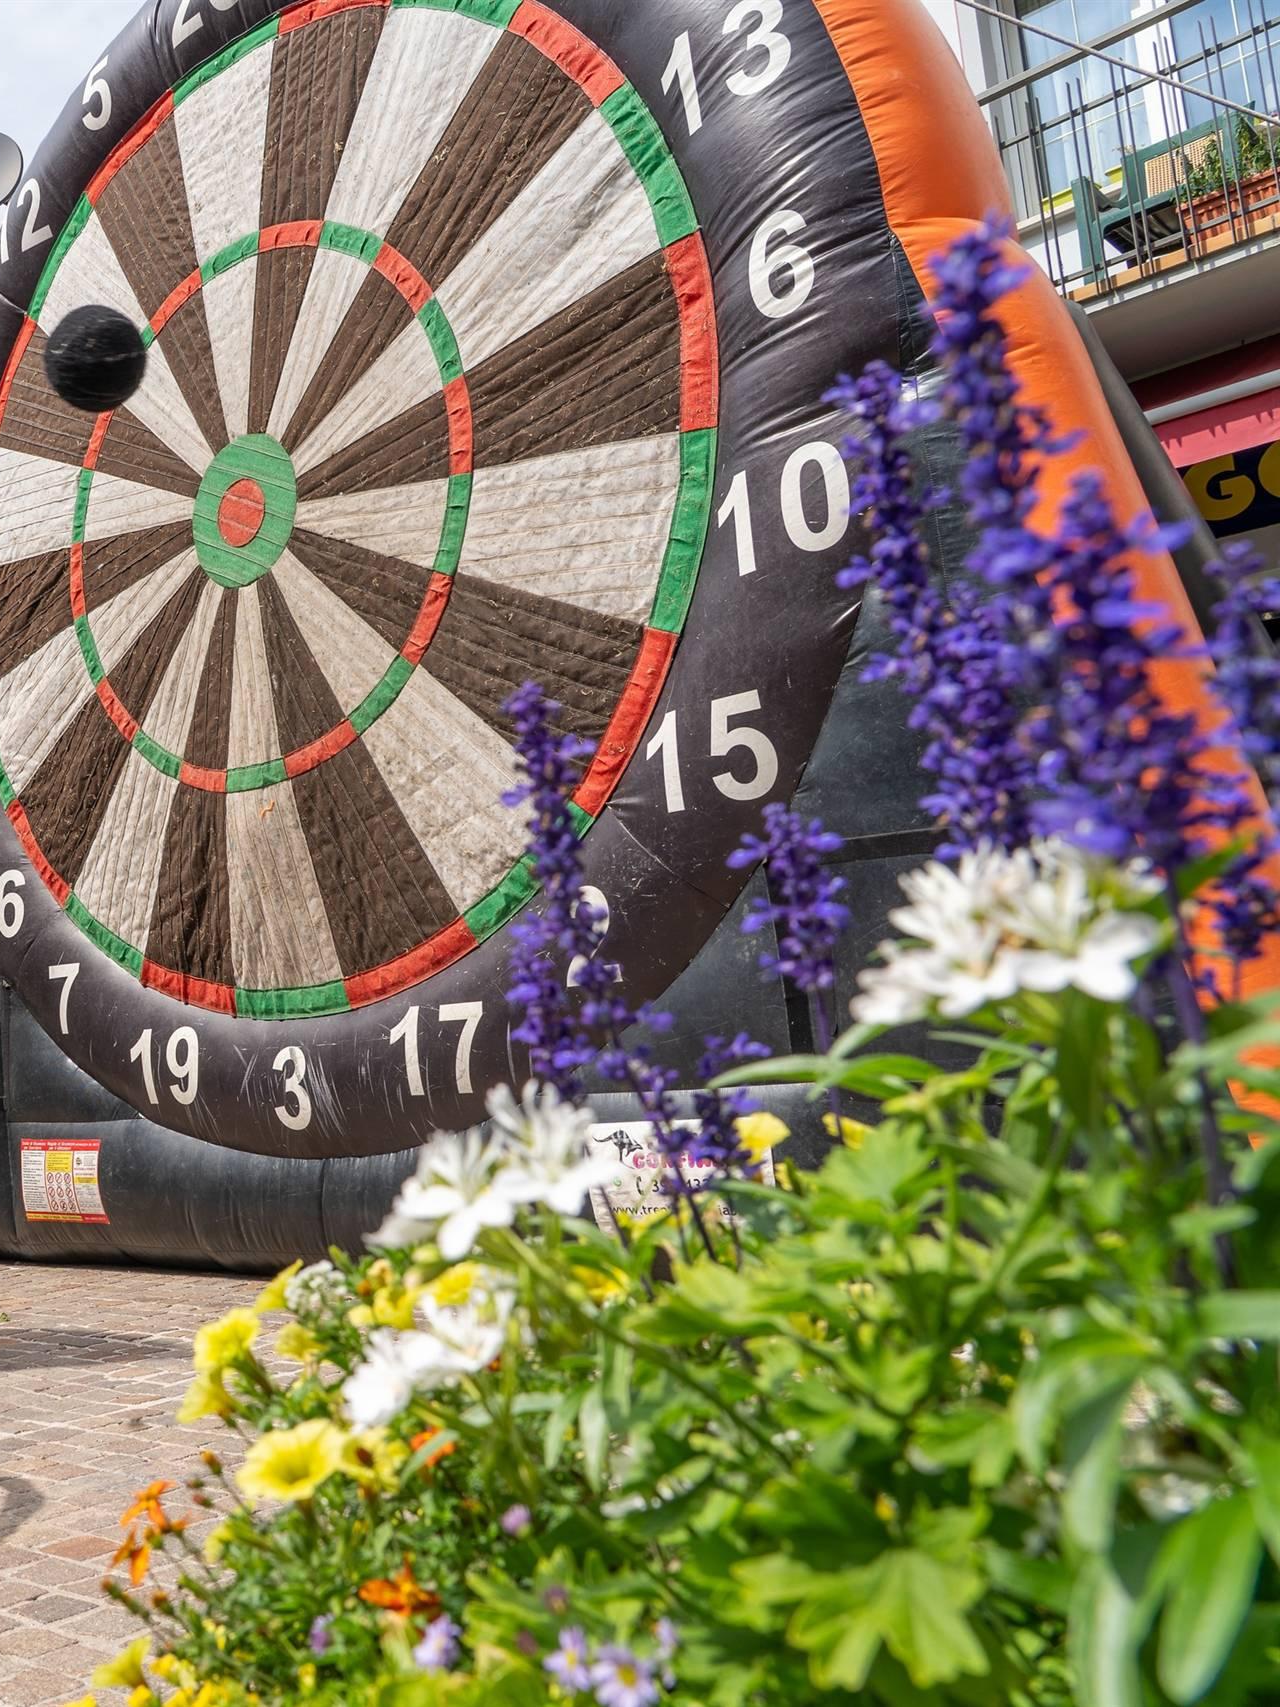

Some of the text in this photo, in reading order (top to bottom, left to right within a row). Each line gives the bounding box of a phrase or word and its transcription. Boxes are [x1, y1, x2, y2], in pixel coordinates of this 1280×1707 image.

[82, 55, 112, 131] 5
[661, 0, 791, 137] 13
[0, 178, 53, 264] 12
[749, 209, 815, 319] 6
[718, 441, 851, 577] 10
[646, 689, 779, 813] 15
[48, 962, 80, 1035] 7
[130, 1026, 199, 1105] 19
[272, 1046, 312, 1131] 3
[389, 1001, 483, 1096] 17
